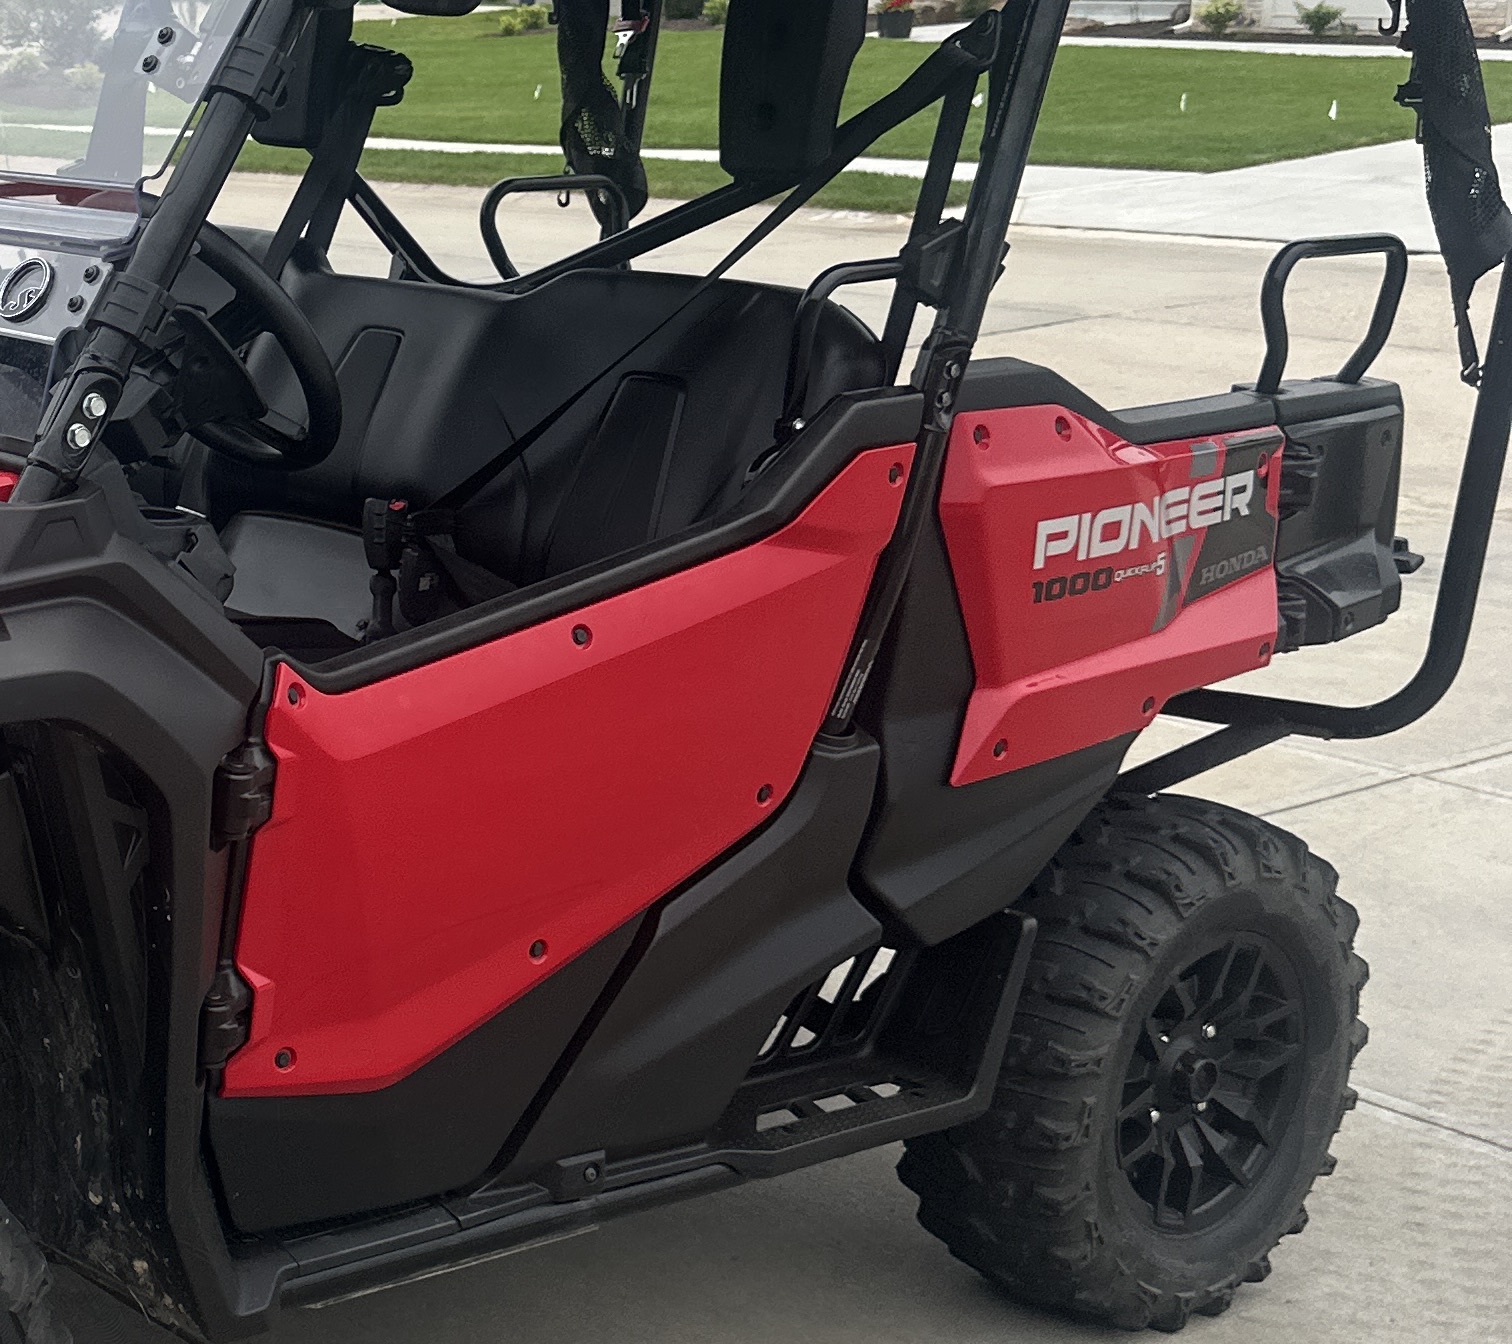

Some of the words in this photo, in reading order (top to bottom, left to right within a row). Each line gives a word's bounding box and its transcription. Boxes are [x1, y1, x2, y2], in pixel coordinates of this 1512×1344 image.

[1033, 469, 1254, 570] PIONEER
[1032, 566, 1113, 604] 1000
[1199, 545, 1270, 585] HONDA
